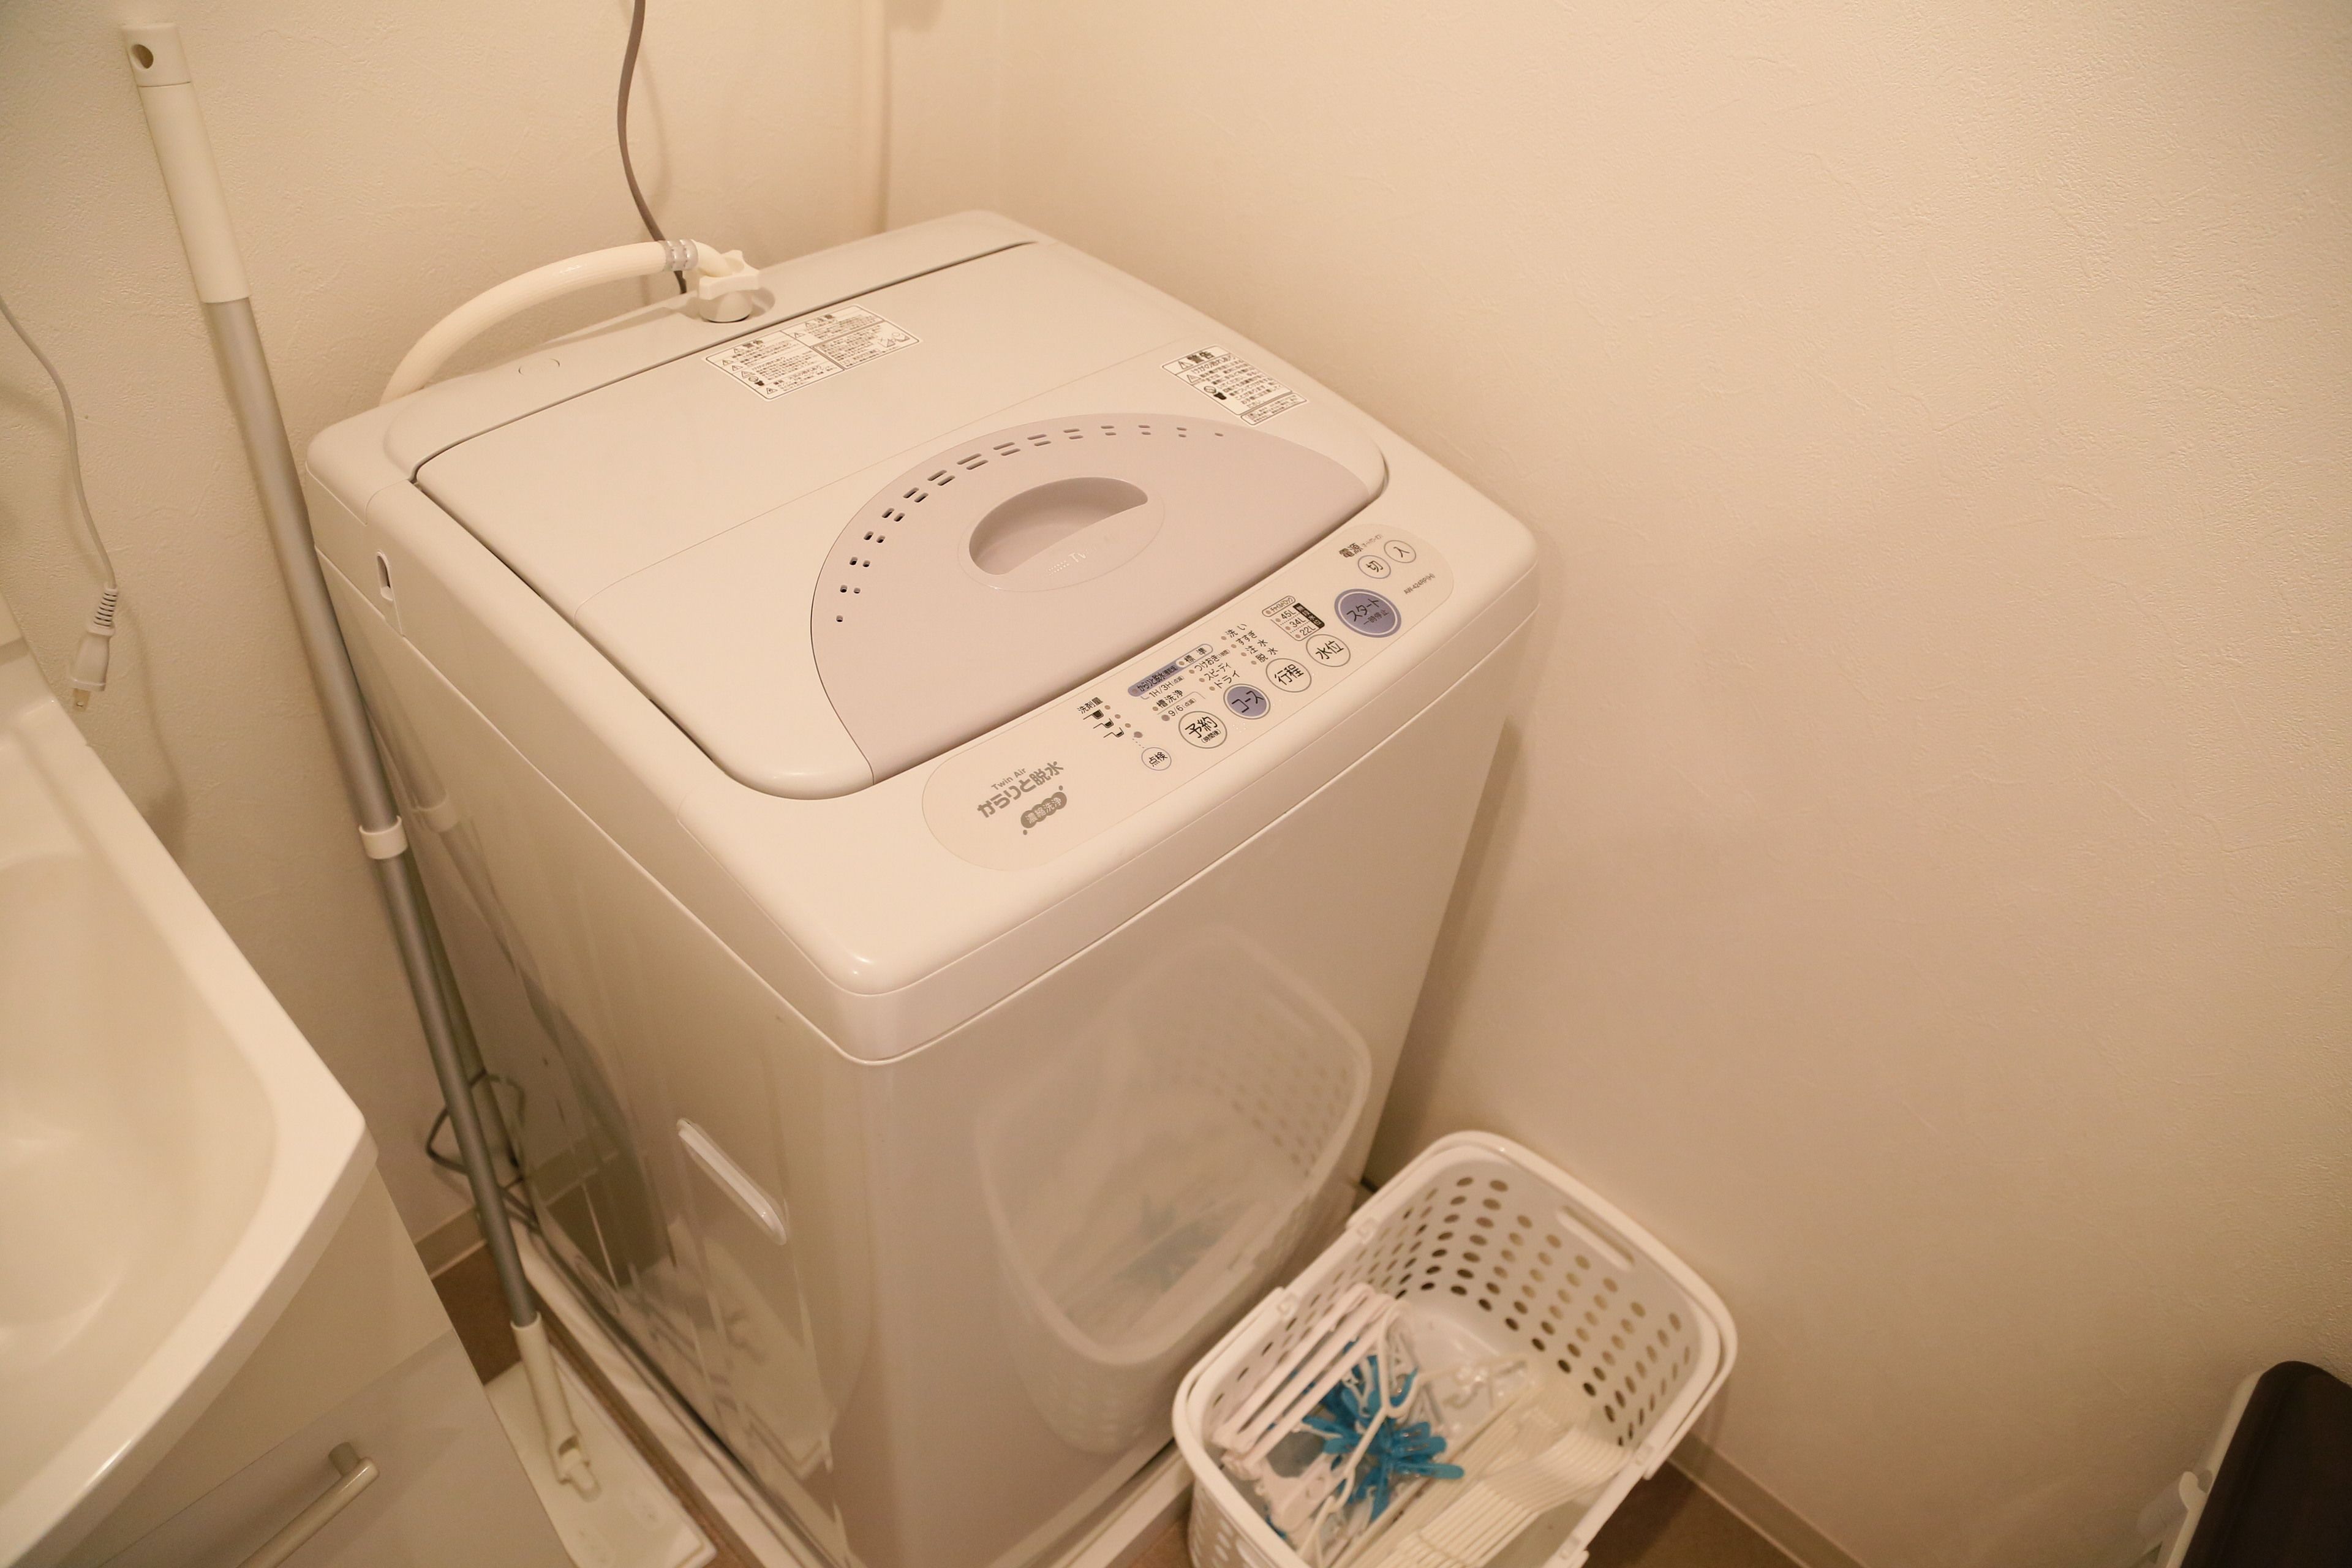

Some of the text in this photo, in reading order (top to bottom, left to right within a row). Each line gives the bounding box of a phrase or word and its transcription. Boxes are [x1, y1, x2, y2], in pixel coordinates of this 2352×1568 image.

[1339, 543, 1363, 558] 電源
[1393, 546, 1410, 558] 入
[1366, 560, 1384, 573] 切
[1281, 609, 1297, 620] 45L
[1346, 598, 1379, 622] スタート
[1363, 609, 1389, 625] 一時停止
[1289, 617, 1306, 628] 34L
[1299, 625, 1316, 636] 22L
[1225, 624, 1248, 638] 洗い
[1235, 630, 1257, 646] すすぎ
[1245, 639, 1268, 655] 注水
[1255, 647, 1278, 663] 脱水
[1315, 640, 1344, 660] 水位
[1183, 647, 1208, 664] 標準
[1214, 670, 1240, 689] ドライ
[1274, 663, 1305, 686] 行程
[1077, 697, 1104, 714] 洗剤量
[1156, 690, 1183, 709] 槽洗浄
[1231, 690, 1264, 713] コース
[1185, 716, 1218, 739] 予約
[1148, 752, 1168, 767] 点検
[991, 768, 1026, 791] Twin Air
[977, 761, 1064, 818] からりと脱水
